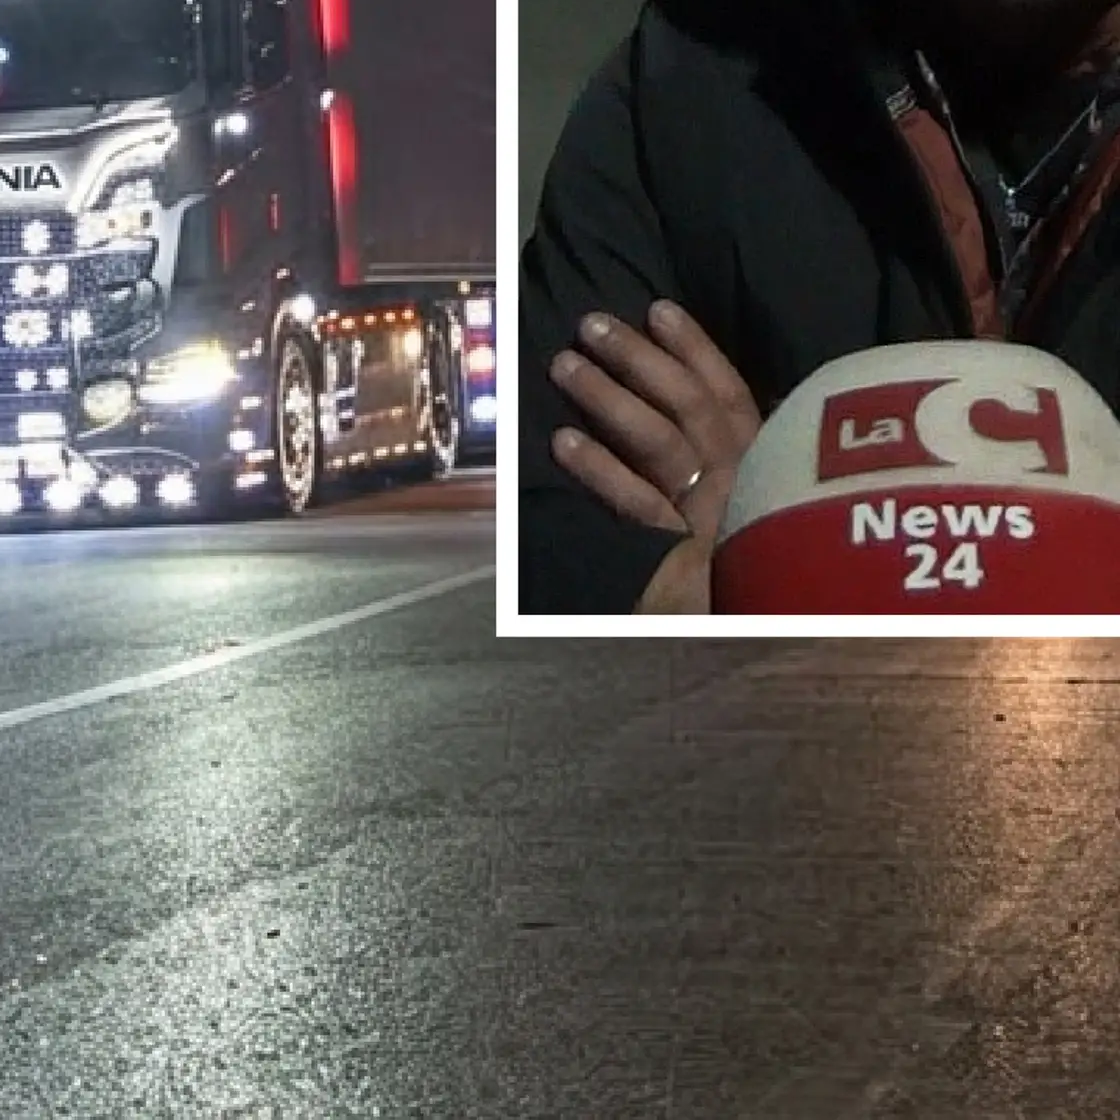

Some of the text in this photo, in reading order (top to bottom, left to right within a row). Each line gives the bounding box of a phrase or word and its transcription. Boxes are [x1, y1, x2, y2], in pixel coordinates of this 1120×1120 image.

[839, 417, 904, 449] La
[851, 498, 1036, 545] News
[903, 541, 984, 589] 24
